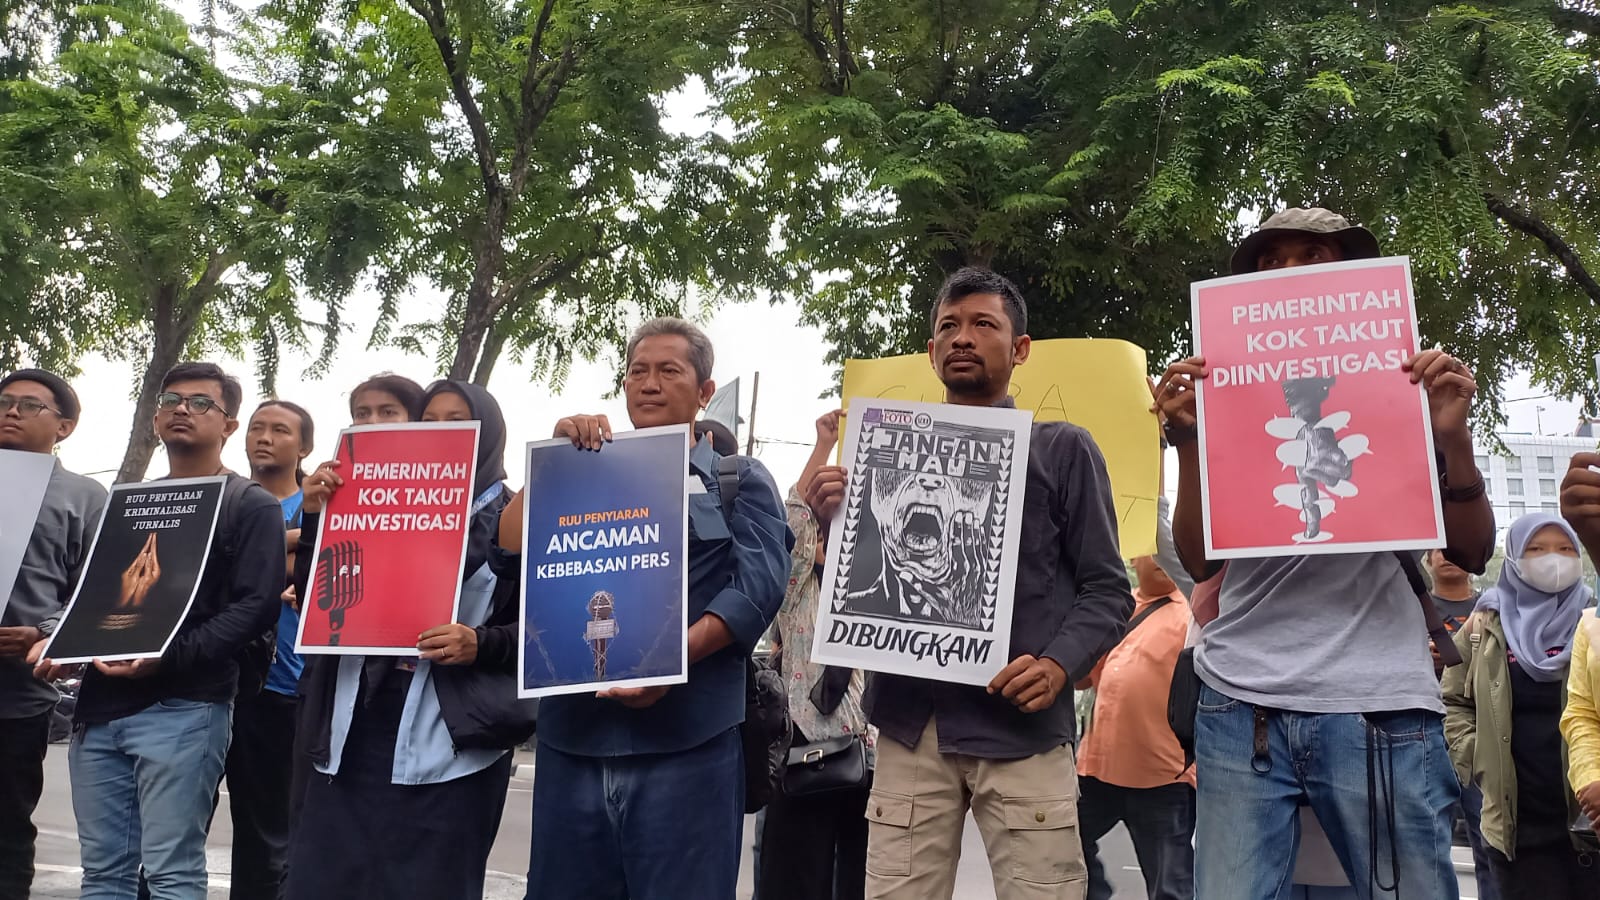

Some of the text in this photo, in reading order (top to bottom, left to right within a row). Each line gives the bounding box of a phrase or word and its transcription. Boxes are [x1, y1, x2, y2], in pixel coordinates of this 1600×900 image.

[1232, 289, 1401, 325] PEMERINTAH
[1246, 319, 1405, 353] KOK TAKUT
[1213, 349, 1409, 388] DIINVESTIGASI
[884, 413, 912, 424] FOTO
[880, 430, 993, 463] JANGAN
[352, 463, 467, 480] PEMERINTAH
[897, 452, 967, 477] MAU
[125, 490, 204, 504] RUU PENYIARAN
[357, 487, 400, 506] KOK
[404, 487, 464, 506] TAKUT
[123, 504, 198, 517] KRIMINALISASI
[559, 507, 649, 527] RUU PENYIARAN
[132, 519, 181, 530] JURNALIS
[329, 513, 461, 531] DIINVESTIGASI
[546, 523, 660, 554] ANCAMAN
[536, 552, 670, 579] KEBEBASAN PERS
[826, 619, 995, 667] DIBUNGKAM
